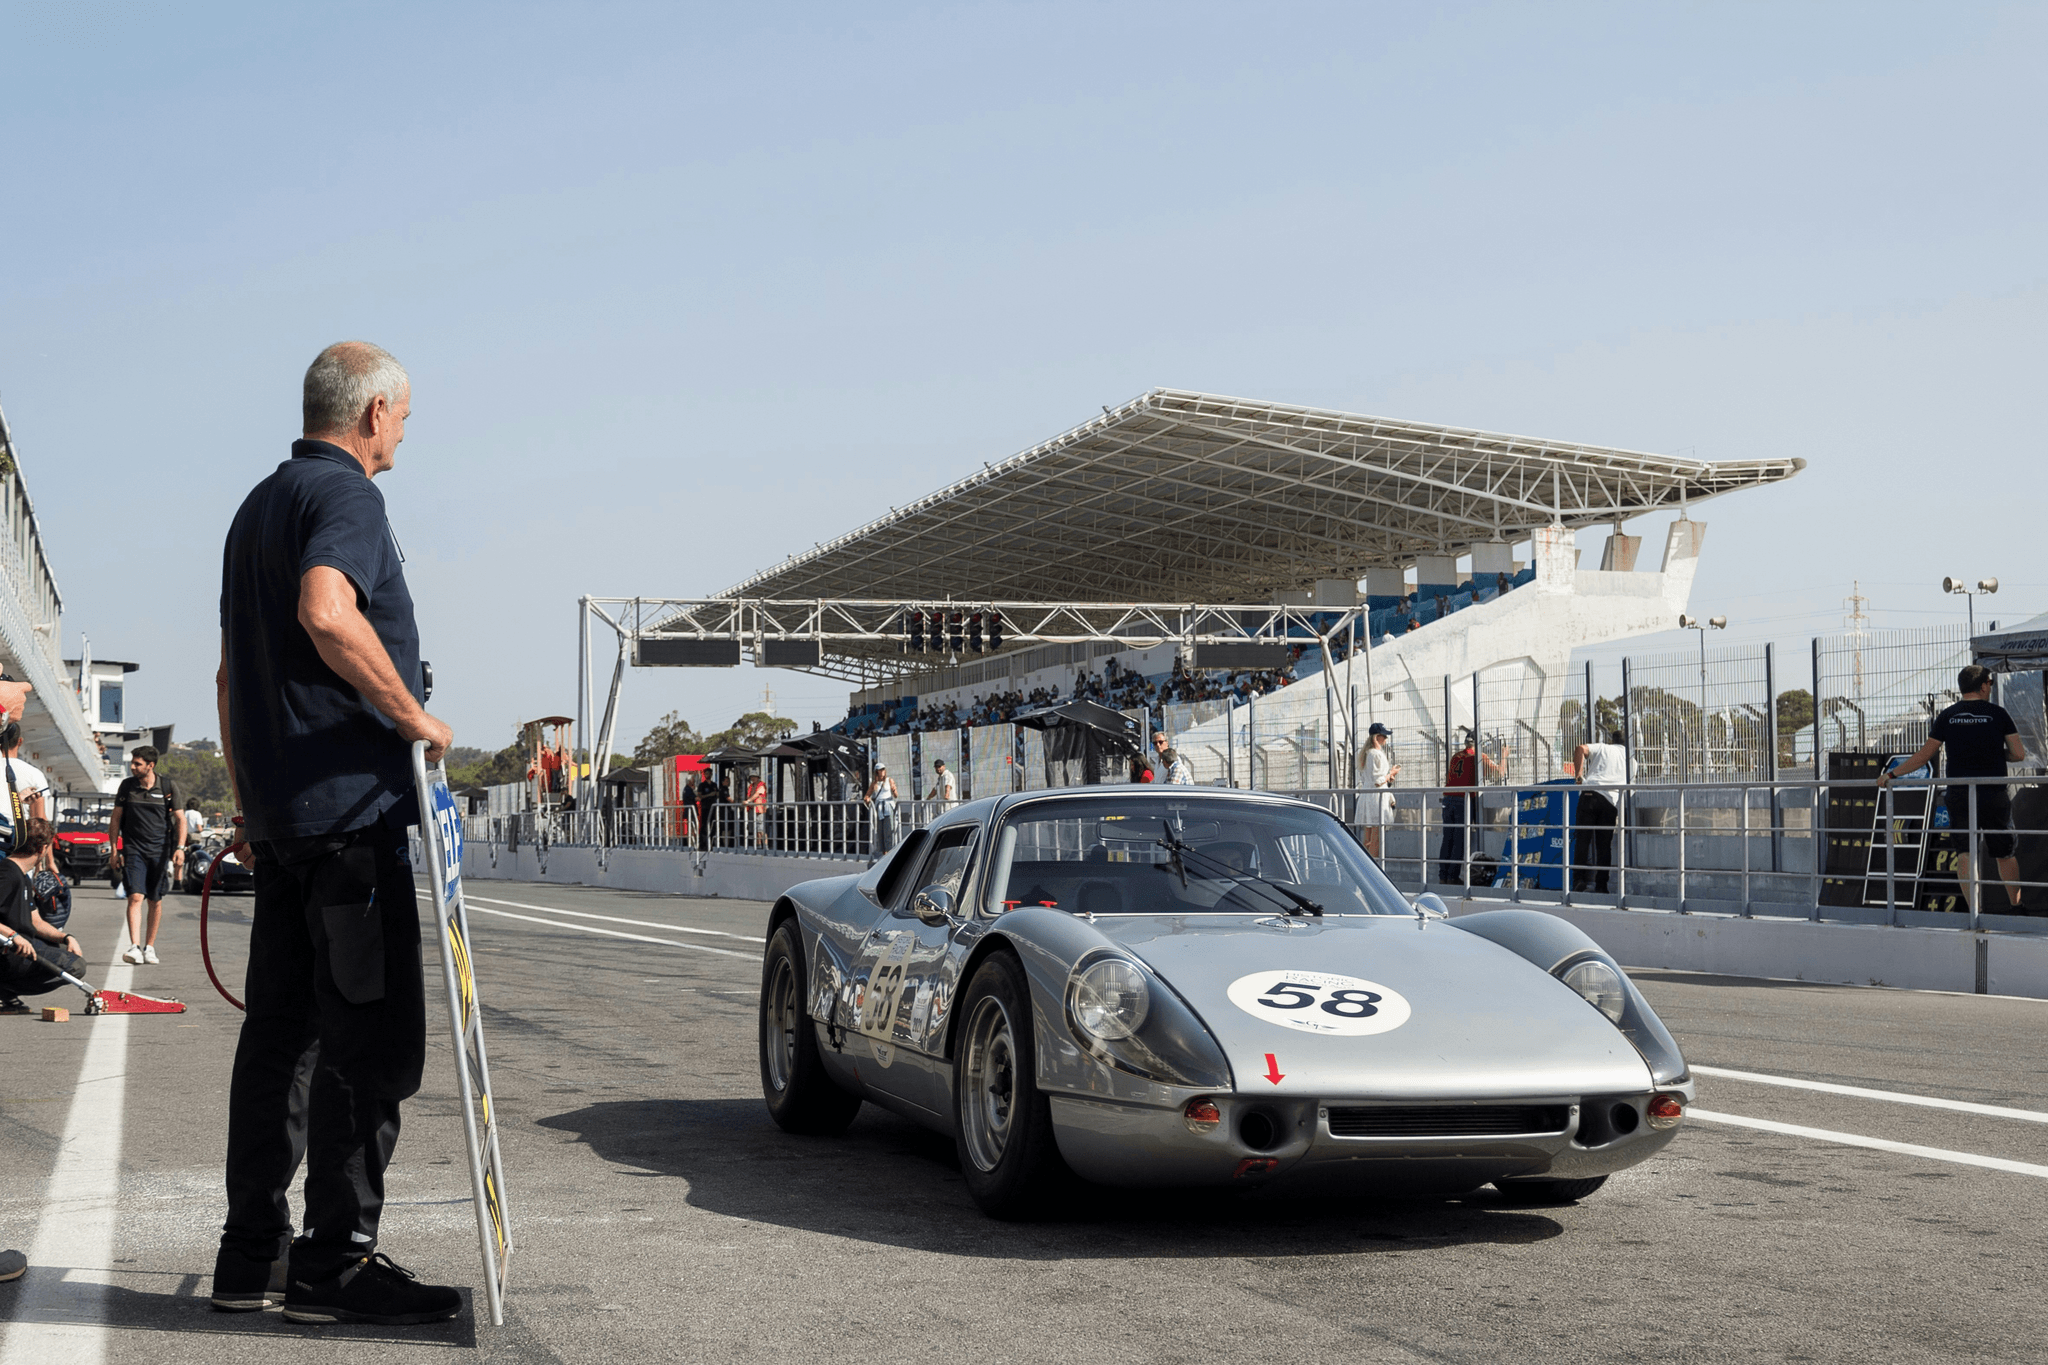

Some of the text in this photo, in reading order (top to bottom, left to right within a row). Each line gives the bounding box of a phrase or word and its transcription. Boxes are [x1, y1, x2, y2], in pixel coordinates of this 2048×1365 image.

[1949, 717, 1988, 725] GIPIMOTOR
[1454, 759, 1464, 778] 4
[11, 791, 22, 819] Nikon
[864, 964, 903, 1033] 58
[1257, 981, 1383, 1018] 58
